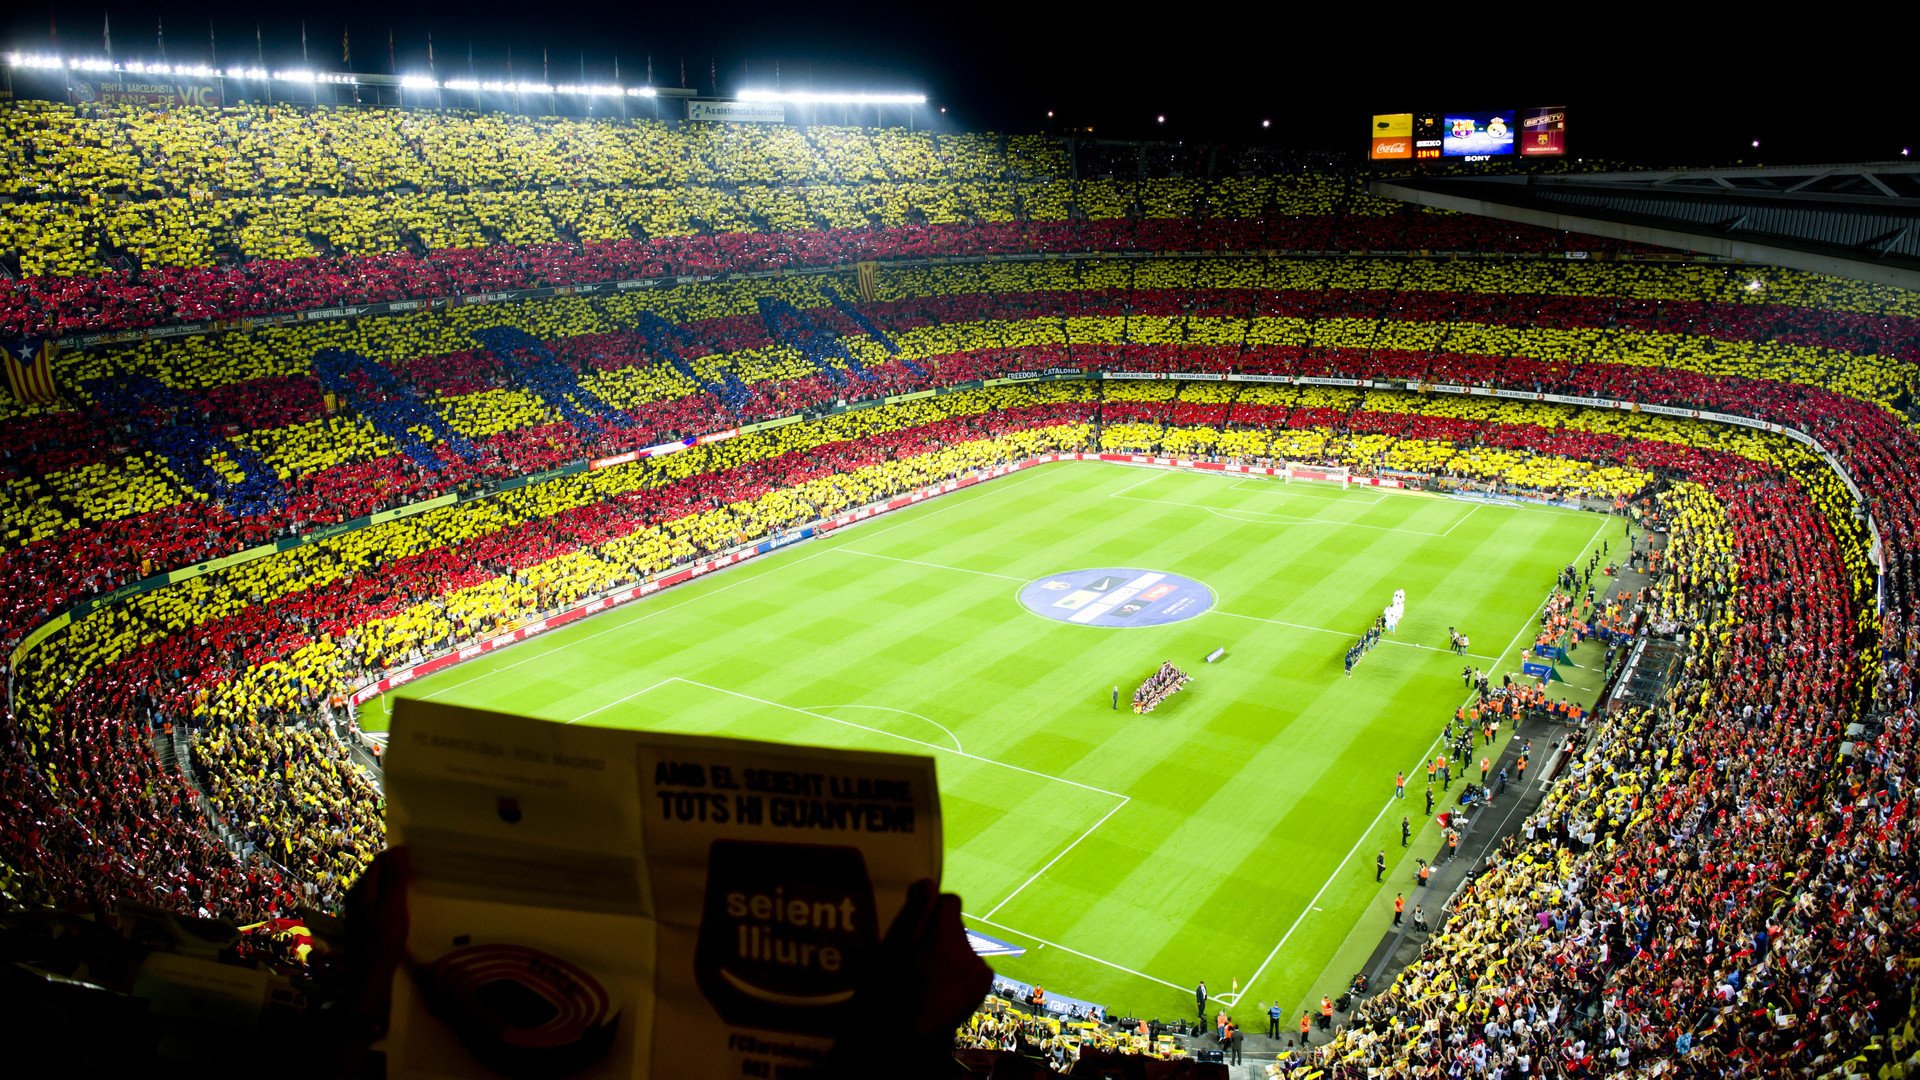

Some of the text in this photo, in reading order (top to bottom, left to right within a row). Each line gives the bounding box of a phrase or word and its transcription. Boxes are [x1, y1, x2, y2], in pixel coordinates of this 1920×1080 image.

[101, 83, 175, 94] PENYA BARCELONISTA
[102, 85, 215, 106] PLANA DE VIC
[307, 307, 357, 319] NIKEFOOTBALL.COM
[147, 327, 176, 337] Botigues
[1007, 371, 1038, 380] FREEDOM
[1043, 367, 1081, 376] CATALONIA
[1558, 396, 1583, 404] TURKISH
[1661, 407, 1689, 416] AIRLINES
[1714, 414, 1763, 428] TURKISH AIRLINES
[655, 760, 913, 804] AMB EL SEIENT LLIURE
[657, 792, 915, 833] TOTS HI GUANYEM!
[726, 882, 856, 932] seient
[738, 925, 843, 974] lliure
